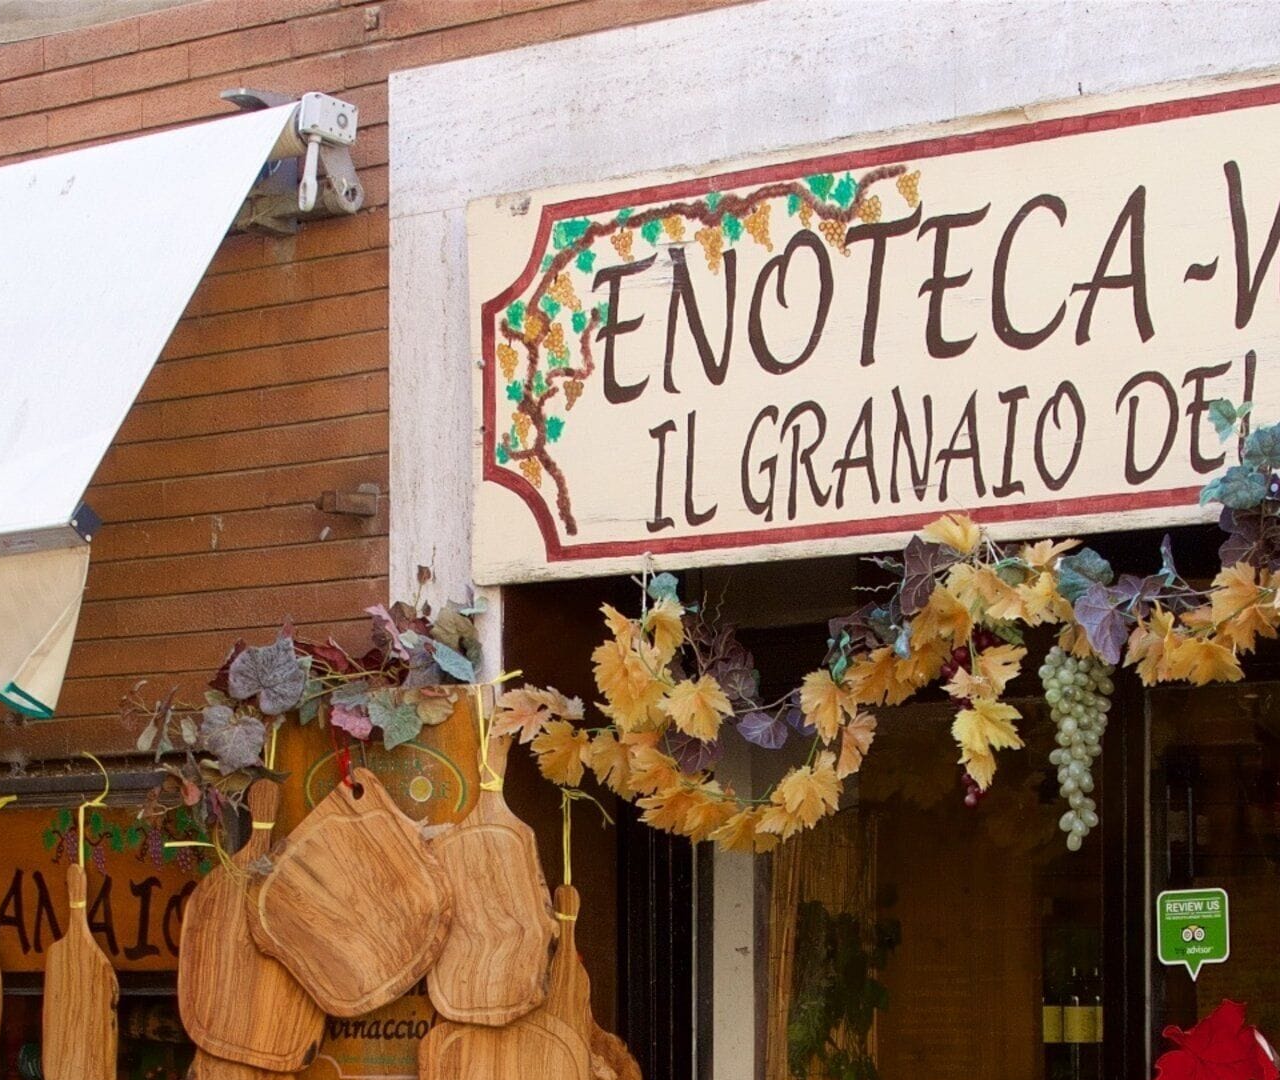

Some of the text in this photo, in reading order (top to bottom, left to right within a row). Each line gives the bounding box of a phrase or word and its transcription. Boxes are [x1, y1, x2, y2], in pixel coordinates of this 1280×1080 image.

[645, 410, 718, 533] IL
[741, 379, 1087, 521] GRANAIO
[1166, 900, 1219, 912] REVIEW US
